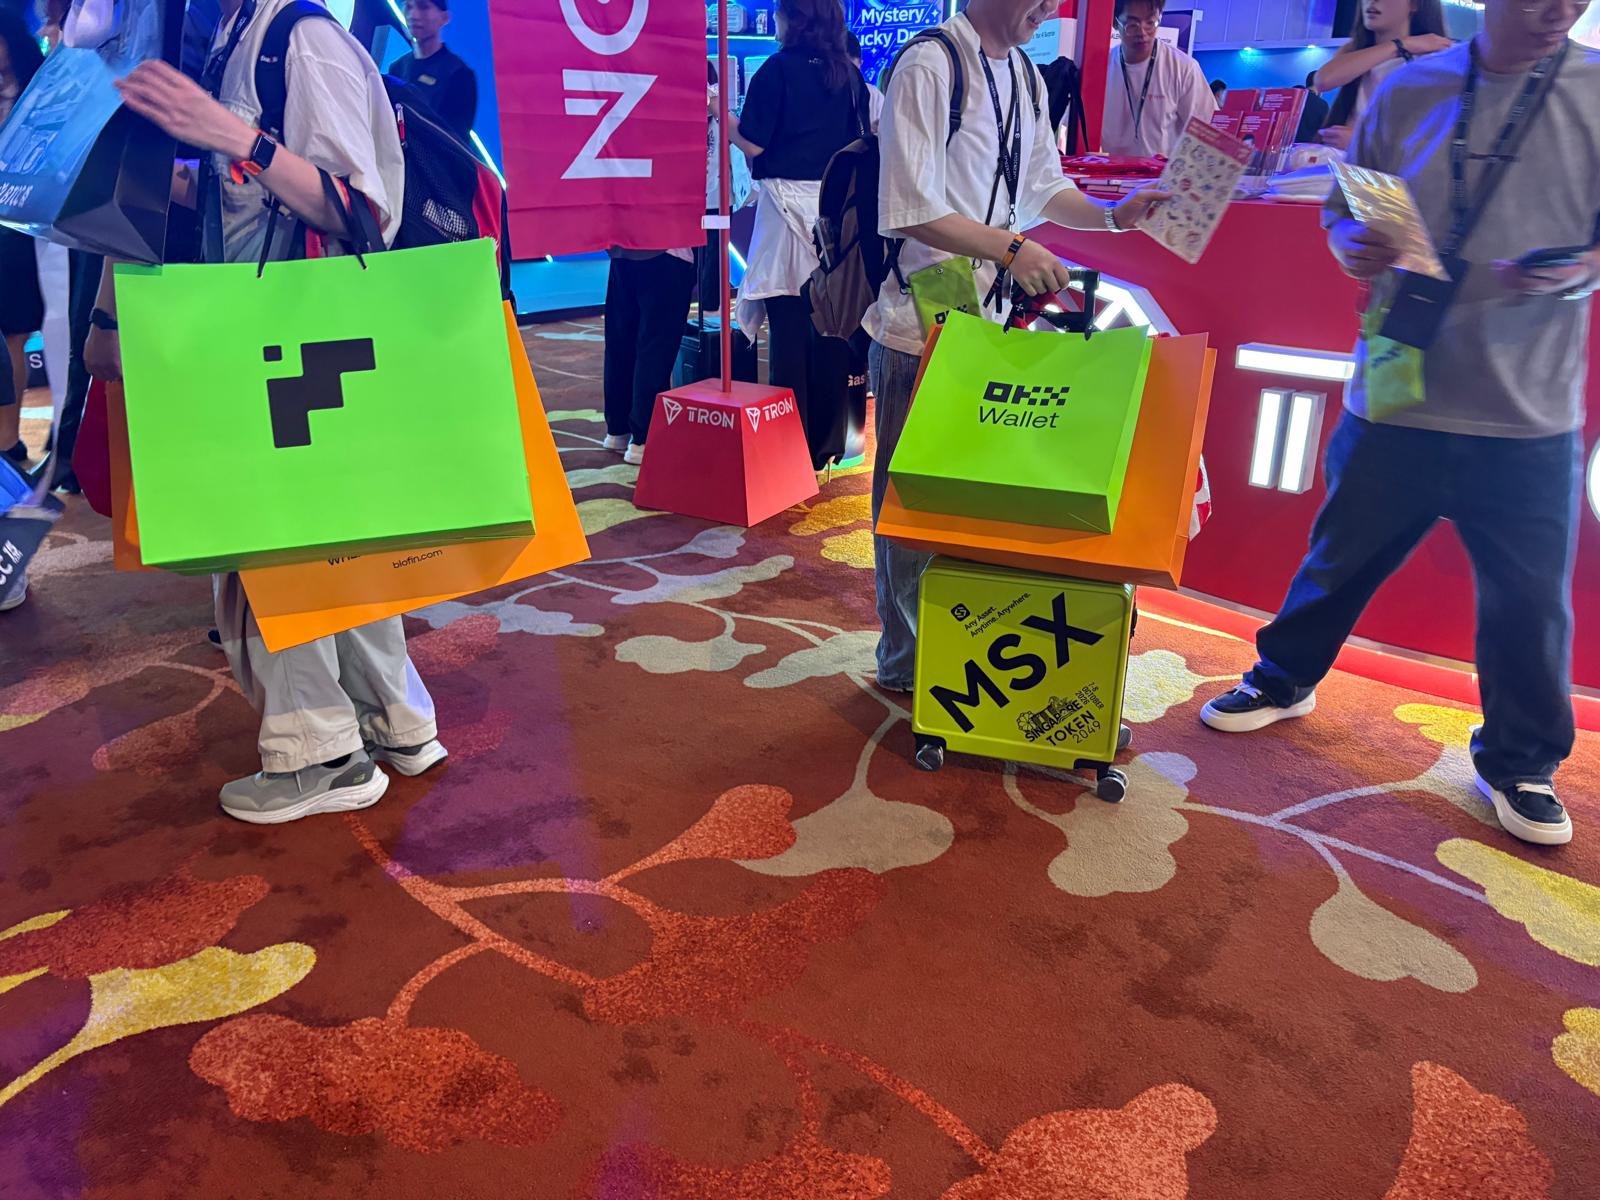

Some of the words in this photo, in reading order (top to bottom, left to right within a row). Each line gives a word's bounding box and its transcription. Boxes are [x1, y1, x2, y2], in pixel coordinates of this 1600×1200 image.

[861, 8, 924, 26] Mystery
[856, 29, 893, 47] ucky
[983, 381, 1070, 406] OKX
[686, 406, 734, 430] TRON
[763, 397, 794, 422] TRON
[979, 406, 1059, 428] Wallet
[392, 550, 442, 568] blofin.com
[964, 619, 978, 631] Any
[977, 606, 997, 622] Asset.
[970, 616, 999, 638] Anytime.
[997, 592, 1031, 618] Anywhere.
[929, 591, 1105, 733] MSX
[1046, 709, 1096, 747] TOKEN
[1072, 720, 1101, 744] 2049
